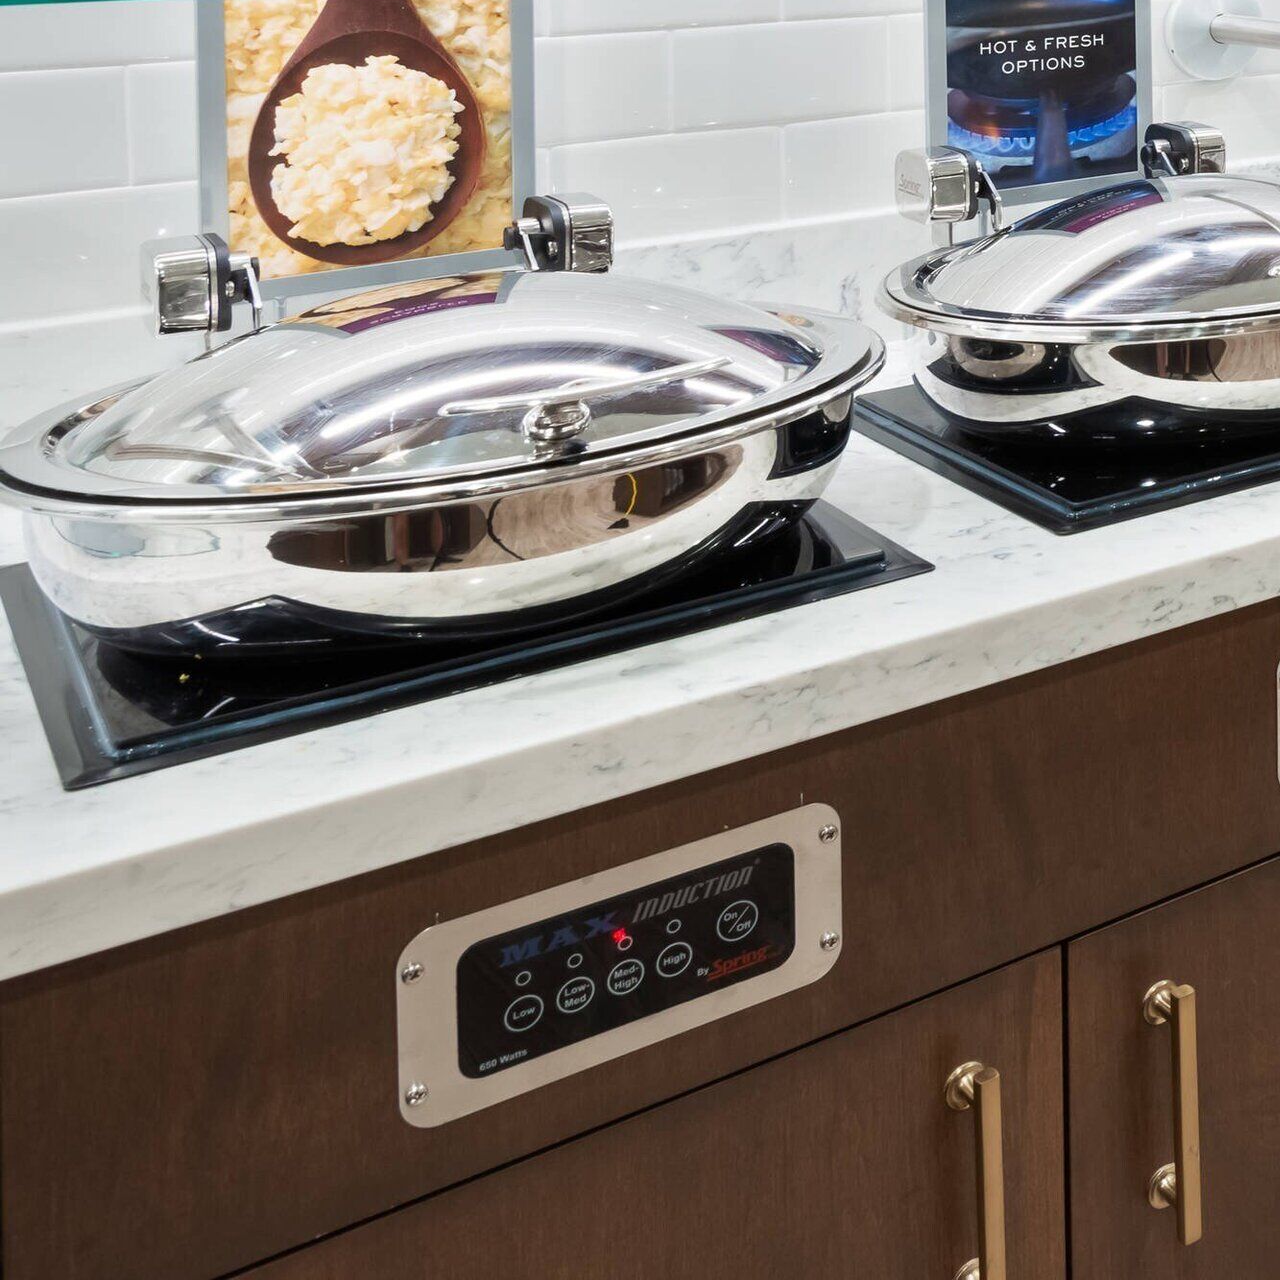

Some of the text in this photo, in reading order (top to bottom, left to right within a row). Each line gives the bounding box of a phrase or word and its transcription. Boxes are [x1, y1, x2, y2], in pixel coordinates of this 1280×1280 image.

[979, 33, 1104, 55] HOT & FRESH
[1001, 55, 1086, 74] OPTIONS
[500, 864, 755, 968] MAX INDUCTION
[723, 911, 739, 922] On
[662, 951, 687, 967] High
[696, 945, 769, 979] By Spring
[614, 976, 639, 991] High
[563, 994, 588, 1009] Med
[512, 1005, 536, 1021] Low
[478, 1048, 529, 1072] 650 Watts
